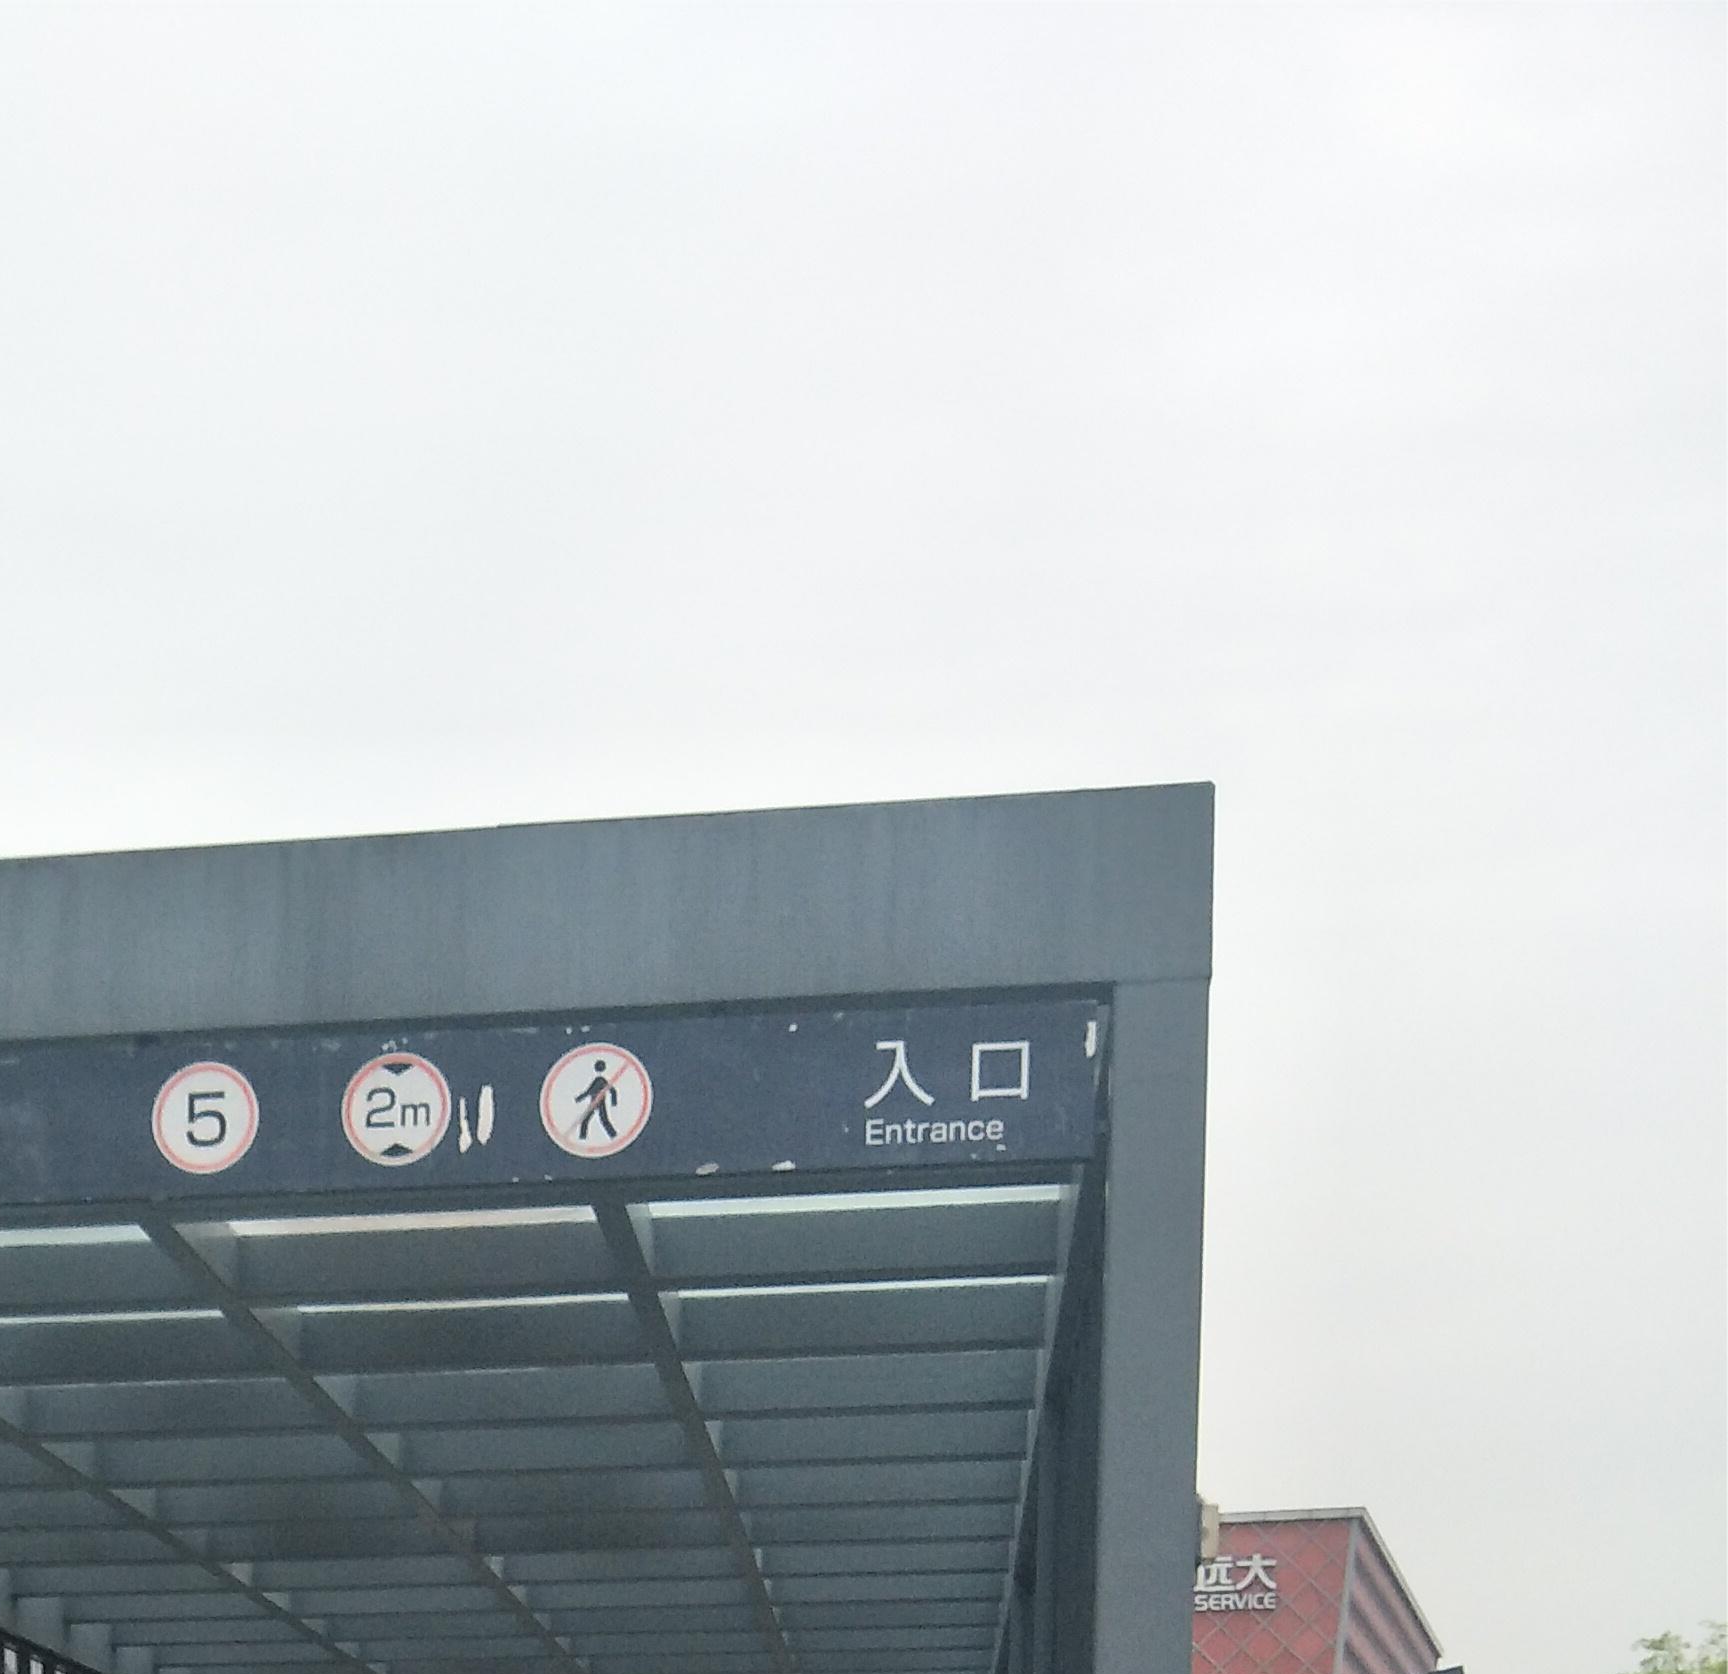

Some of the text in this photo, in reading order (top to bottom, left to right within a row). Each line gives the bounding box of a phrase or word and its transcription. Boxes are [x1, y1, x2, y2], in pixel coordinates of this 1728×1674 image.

[864, 1039, 1031, 1107] 入口
[186, 1090, 227, 1148] 5
[366, 1086, 431, 1131] 2m
[865, 1114, 1004, 1145] Entrance
[1194, 1592, 1277, 1612] SERVICE
